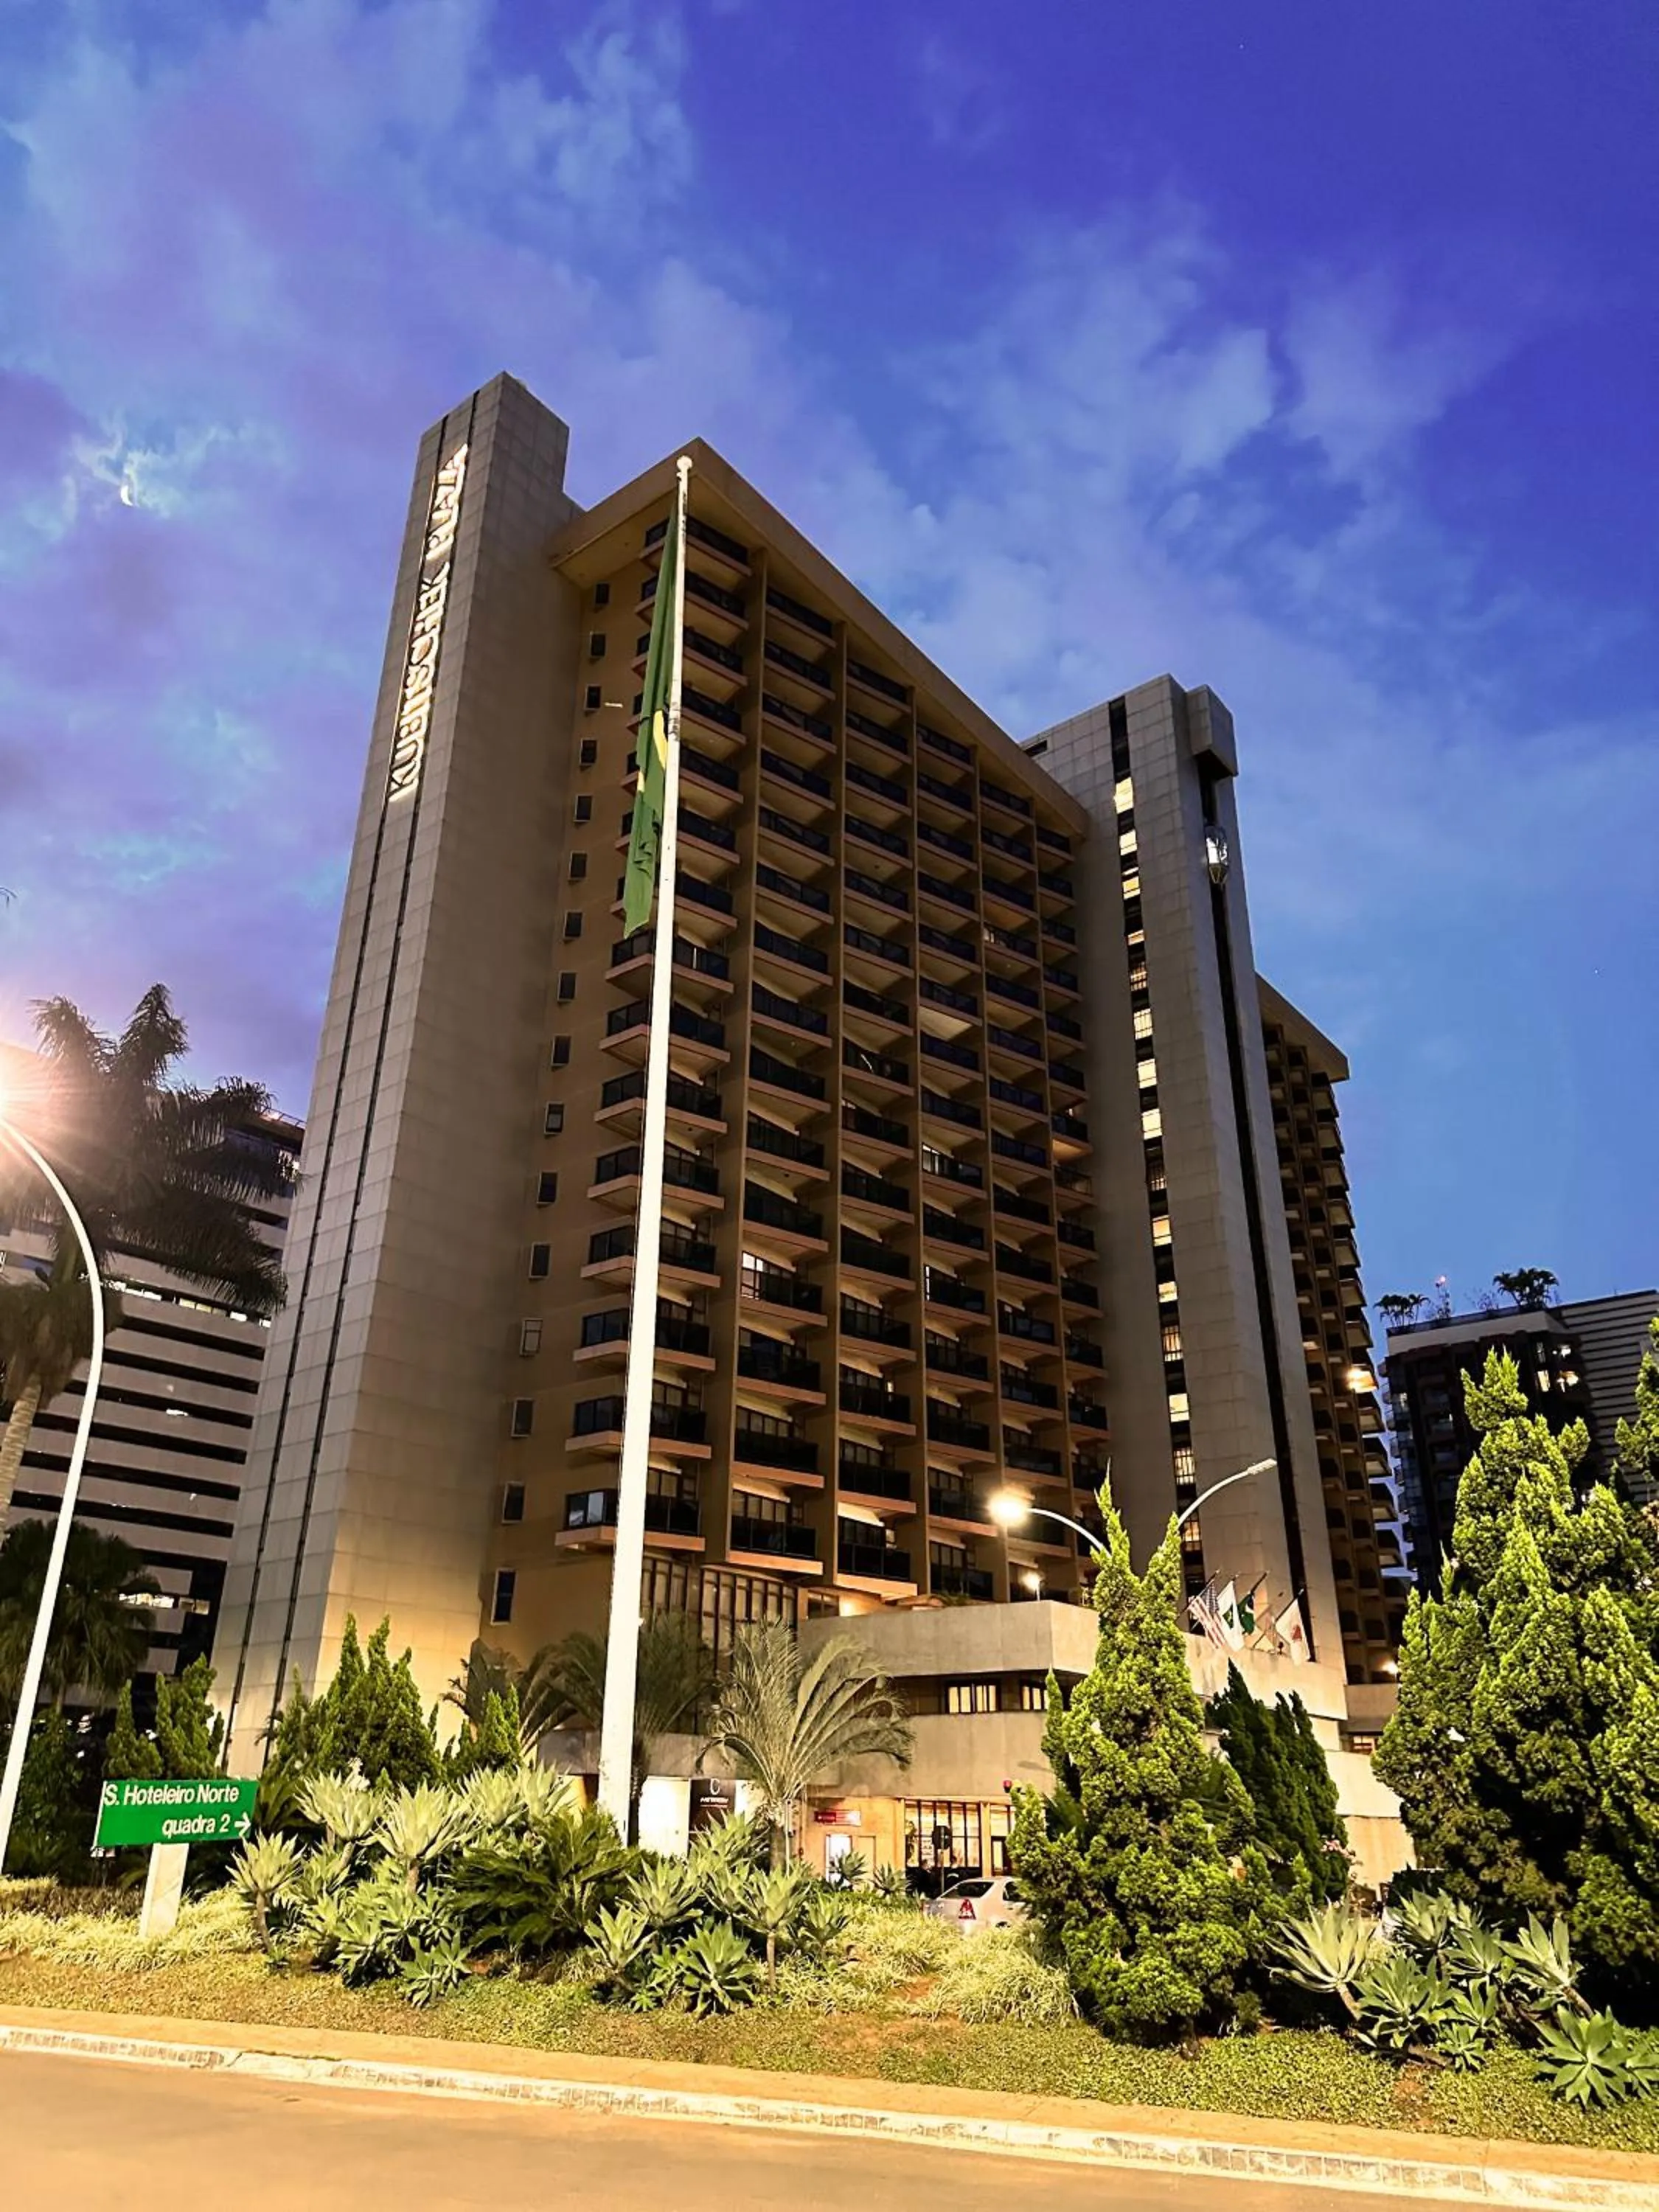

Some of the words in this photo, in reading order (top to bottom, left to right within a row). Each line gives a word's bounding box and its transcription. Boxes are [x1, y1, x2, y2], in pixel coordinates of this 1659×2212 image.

[388, 562, 448, 803] KUBITSCHEK
[426, 442, 468, 560] PLAZA
[103, 1784, 119, 1806] S.
[124, 1784, 195, 1806] Hoteleiro
[196, 1784, 239, 1804] Norte
[161, 1815, 215, 1838] quadra
[220, 1813, 230, 1832] 2
